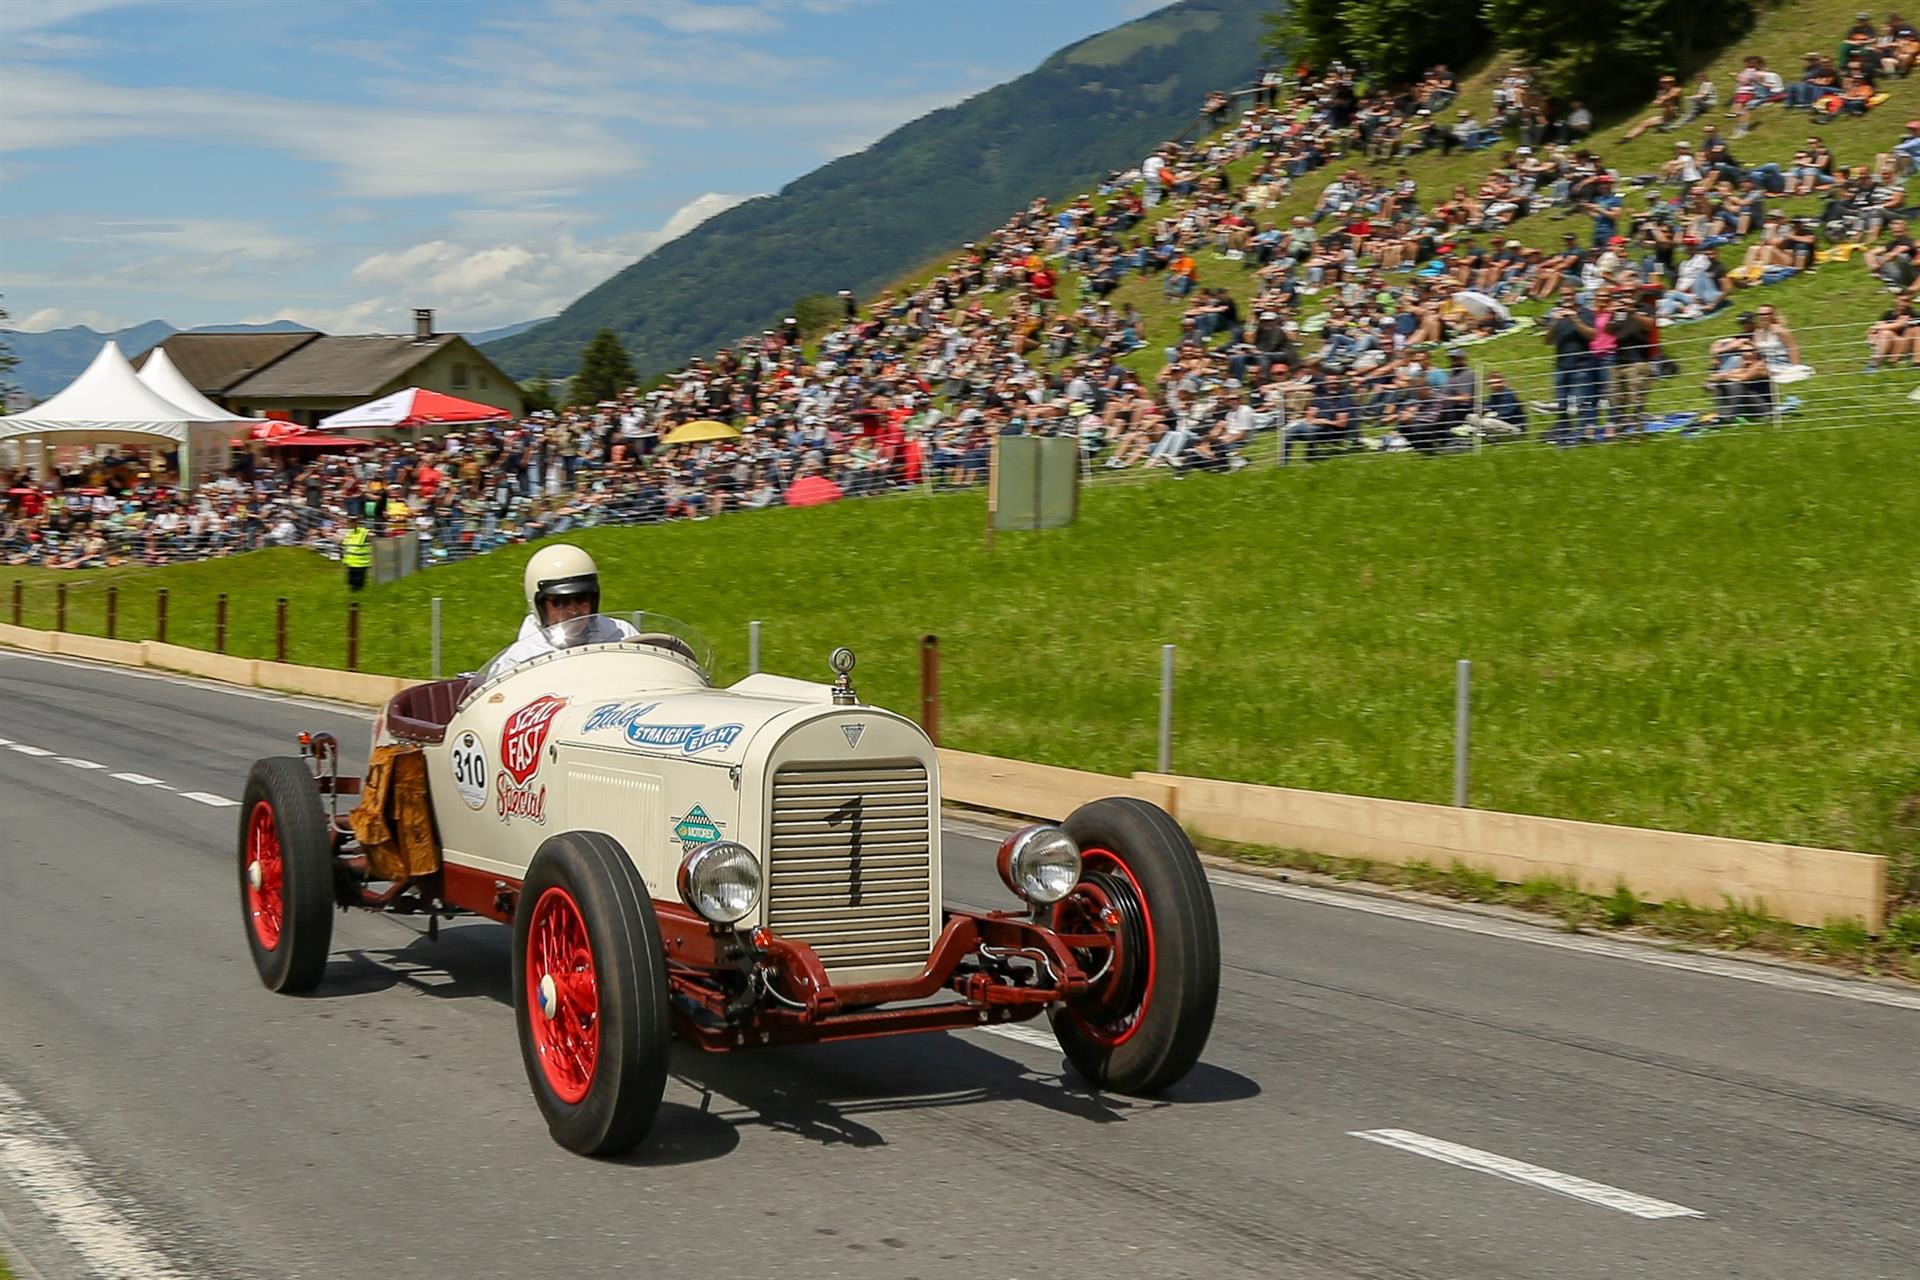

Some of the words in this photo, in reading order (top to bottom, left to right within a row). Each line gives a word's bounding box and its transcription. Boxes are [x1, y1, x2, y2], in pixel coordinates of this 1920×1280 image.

[509, 701, 559, 734] SEAL
[582, 702, 662, 734] Buick
[633, 726, 691, 744] STRAIGHT
[691, 727, 740, 749] EIGHT
[508, 723, 544, 771] FAST
[453, 749, 485, 789] 310
[496, 771, 546, 825] Special
[824, 792, 863, 906] 1
